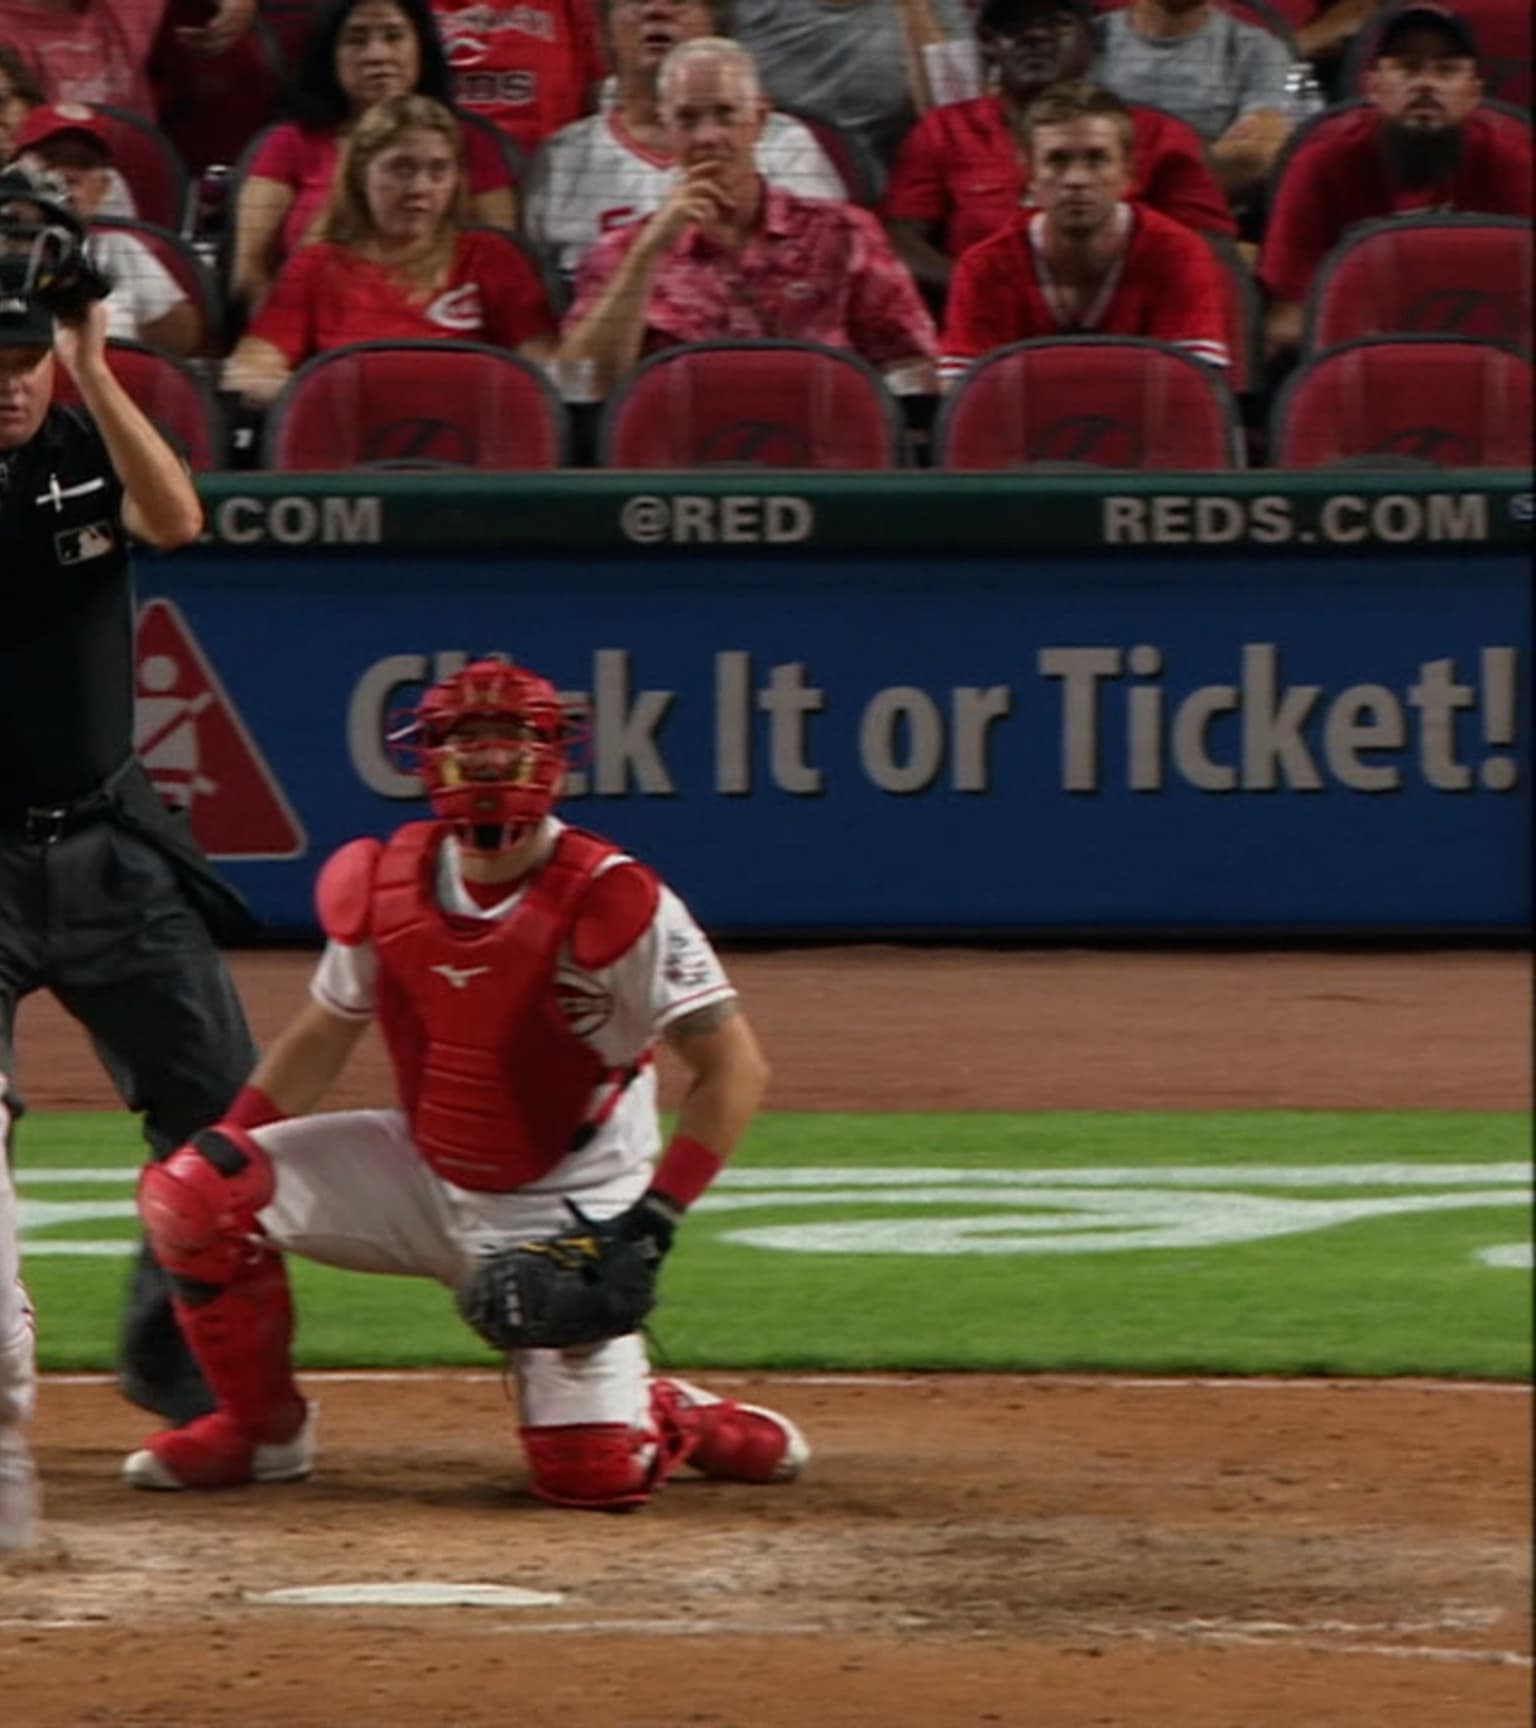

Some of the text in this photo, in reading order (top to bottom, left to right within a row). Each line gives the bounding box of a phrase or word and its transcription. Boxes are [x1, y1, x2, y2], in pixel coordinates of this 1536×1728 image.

[619, 496, 813, 543] @RED
[1103, 495, 1487, 543] REDS.COM
[715, 650, 826, 794] It
[859, 684, 1011, 793] or
[1040, 643, 1517, 792] Ticket!
